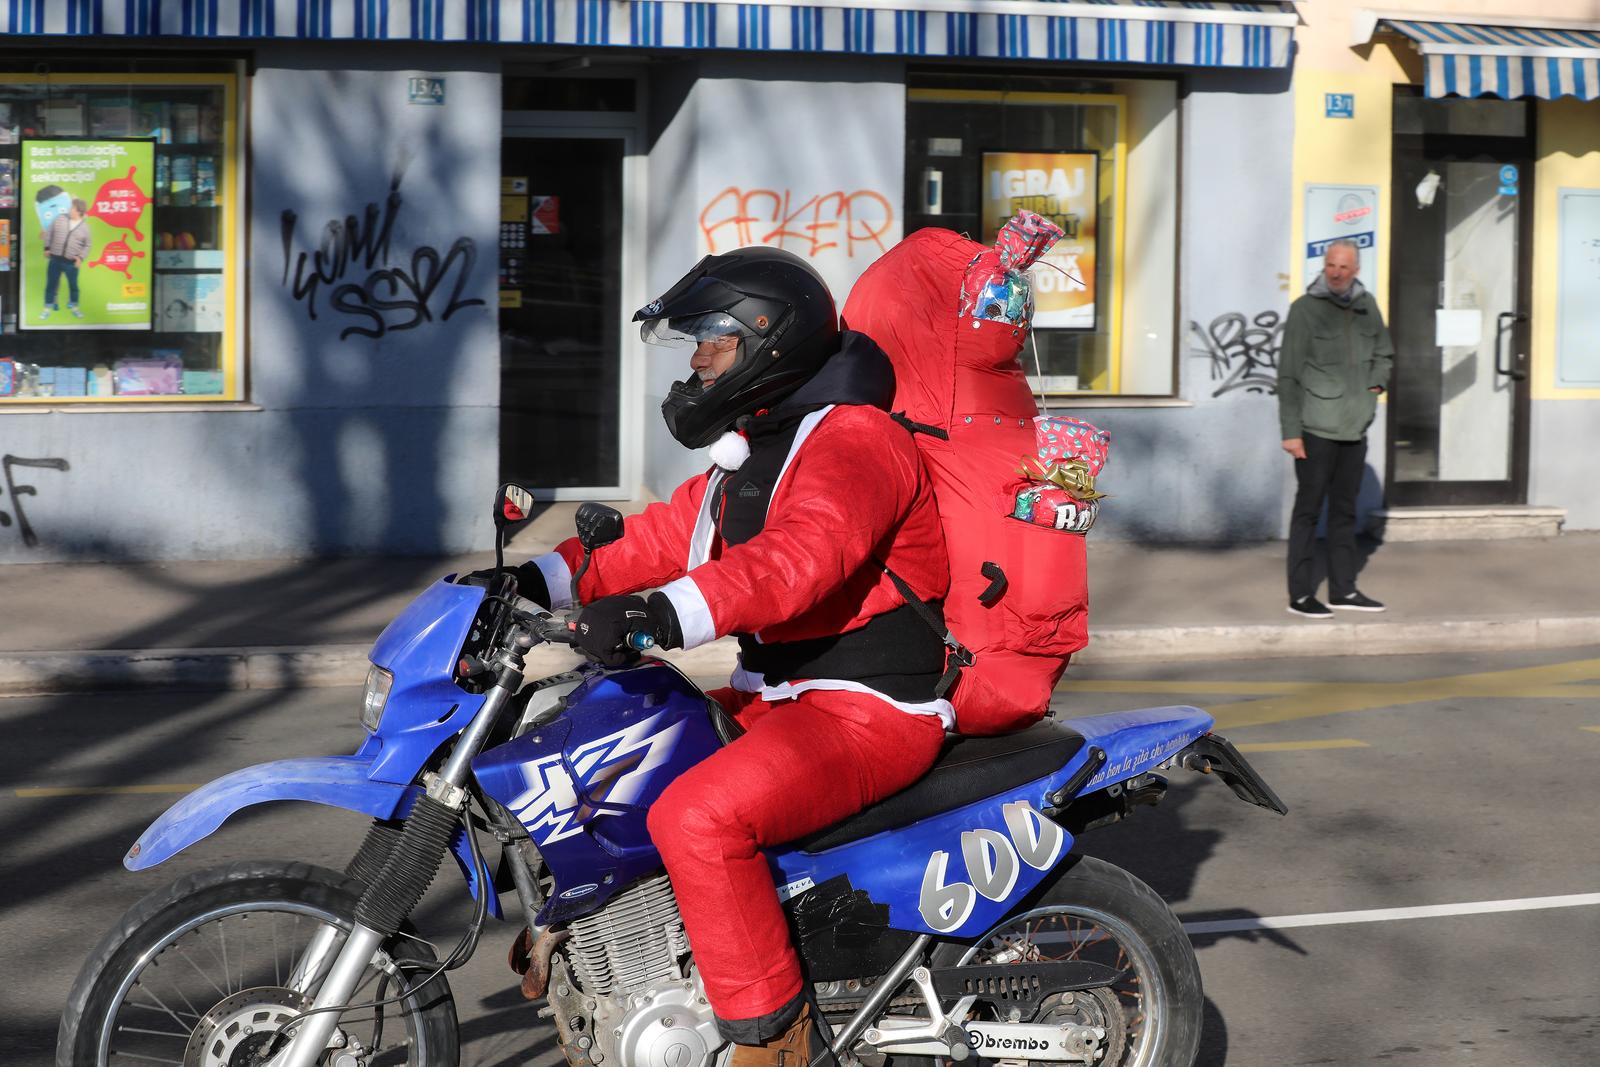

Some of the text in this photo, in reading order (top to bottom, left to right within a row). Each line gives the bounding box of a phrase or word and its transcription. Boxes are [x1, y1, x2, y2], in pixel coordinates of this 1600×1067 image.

[991, 167, 1085, 199] IGRAJ
[918, 800, 1063, 934] 600
[985, 1034, 1050, 1051] brembo
